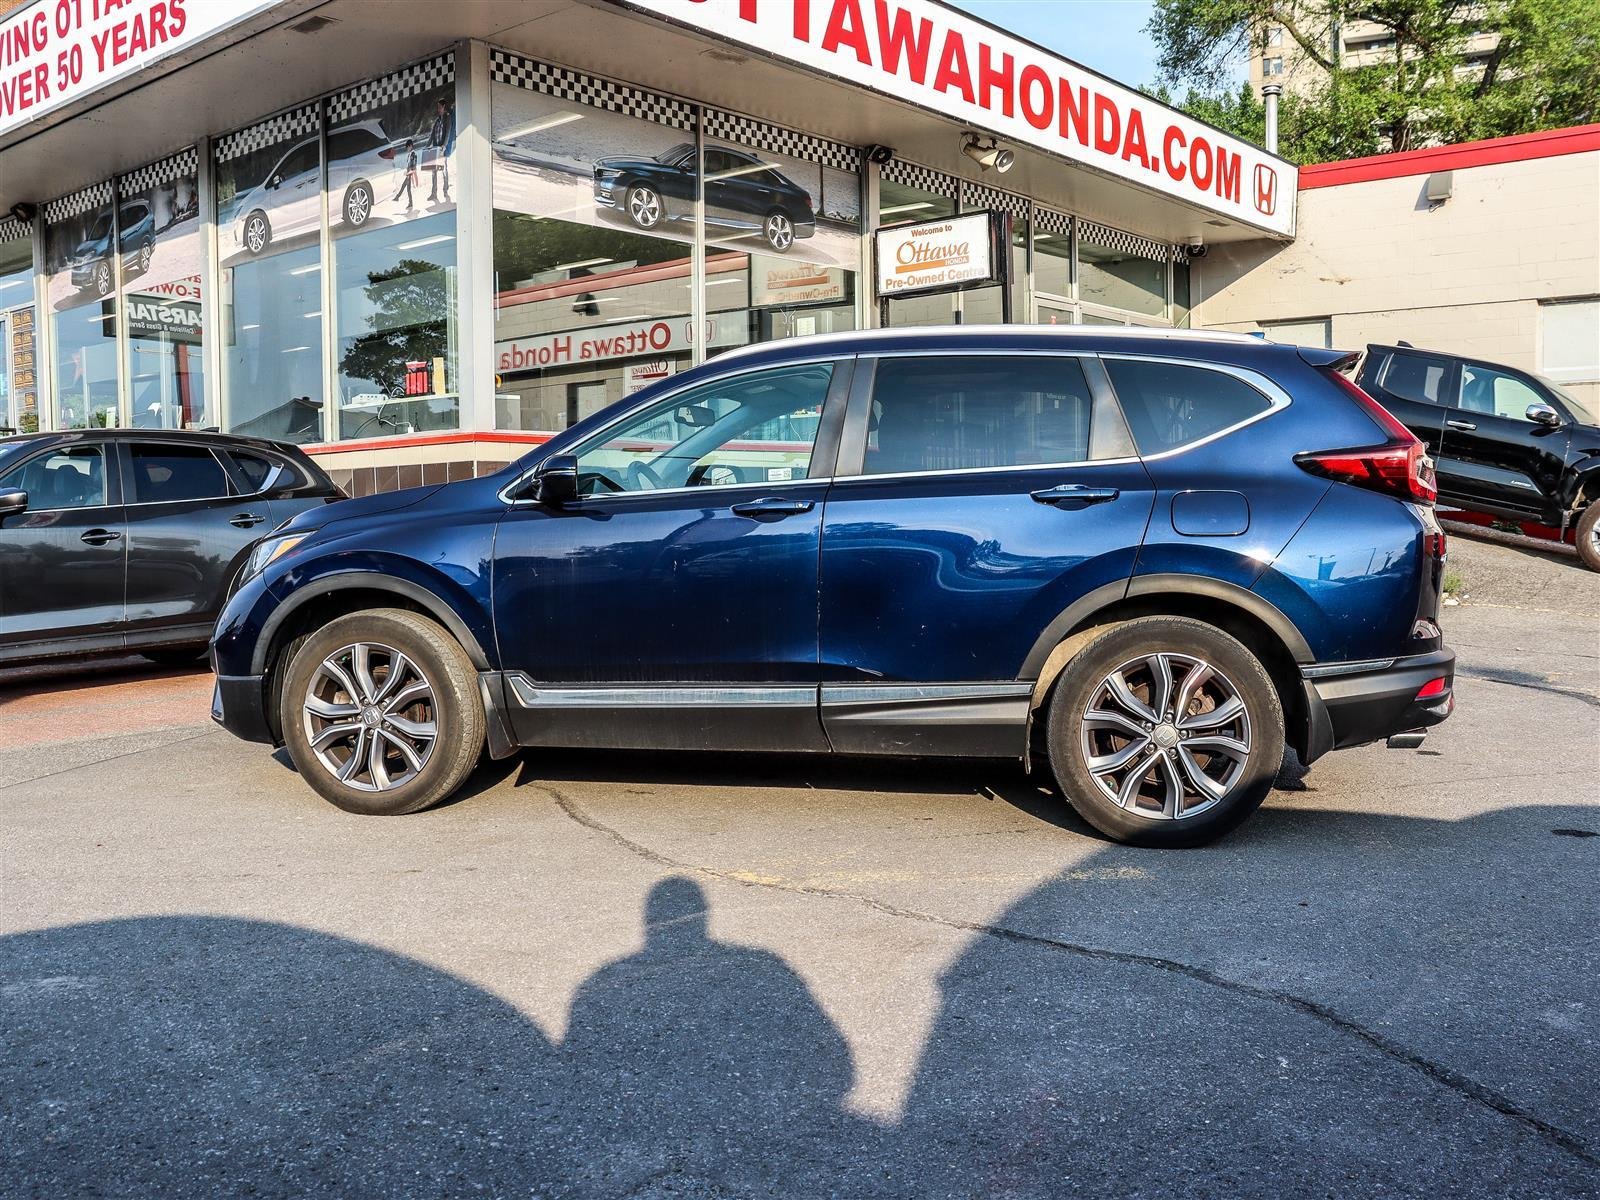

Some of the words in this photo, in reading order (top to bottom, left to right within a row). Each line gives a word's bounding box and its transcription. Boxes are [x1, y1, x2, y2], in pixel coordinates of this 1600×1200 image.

[0, 62, 50, 118] VER
[57, 43, 83, 91] 50
[91, 0, 187, 73] YEARS
[688, 0, 1242, 204] AWAHONDA.COM
[911, 227, 944, 238] Welcome
[944, 224, 953, 233] to
[896, 240, 970, 265] Ottawa
[945, 256, 969, 266] HONDA
[885, 271, 945, 290] Pre-Owned
[947, 266, 985, 280] Centre
